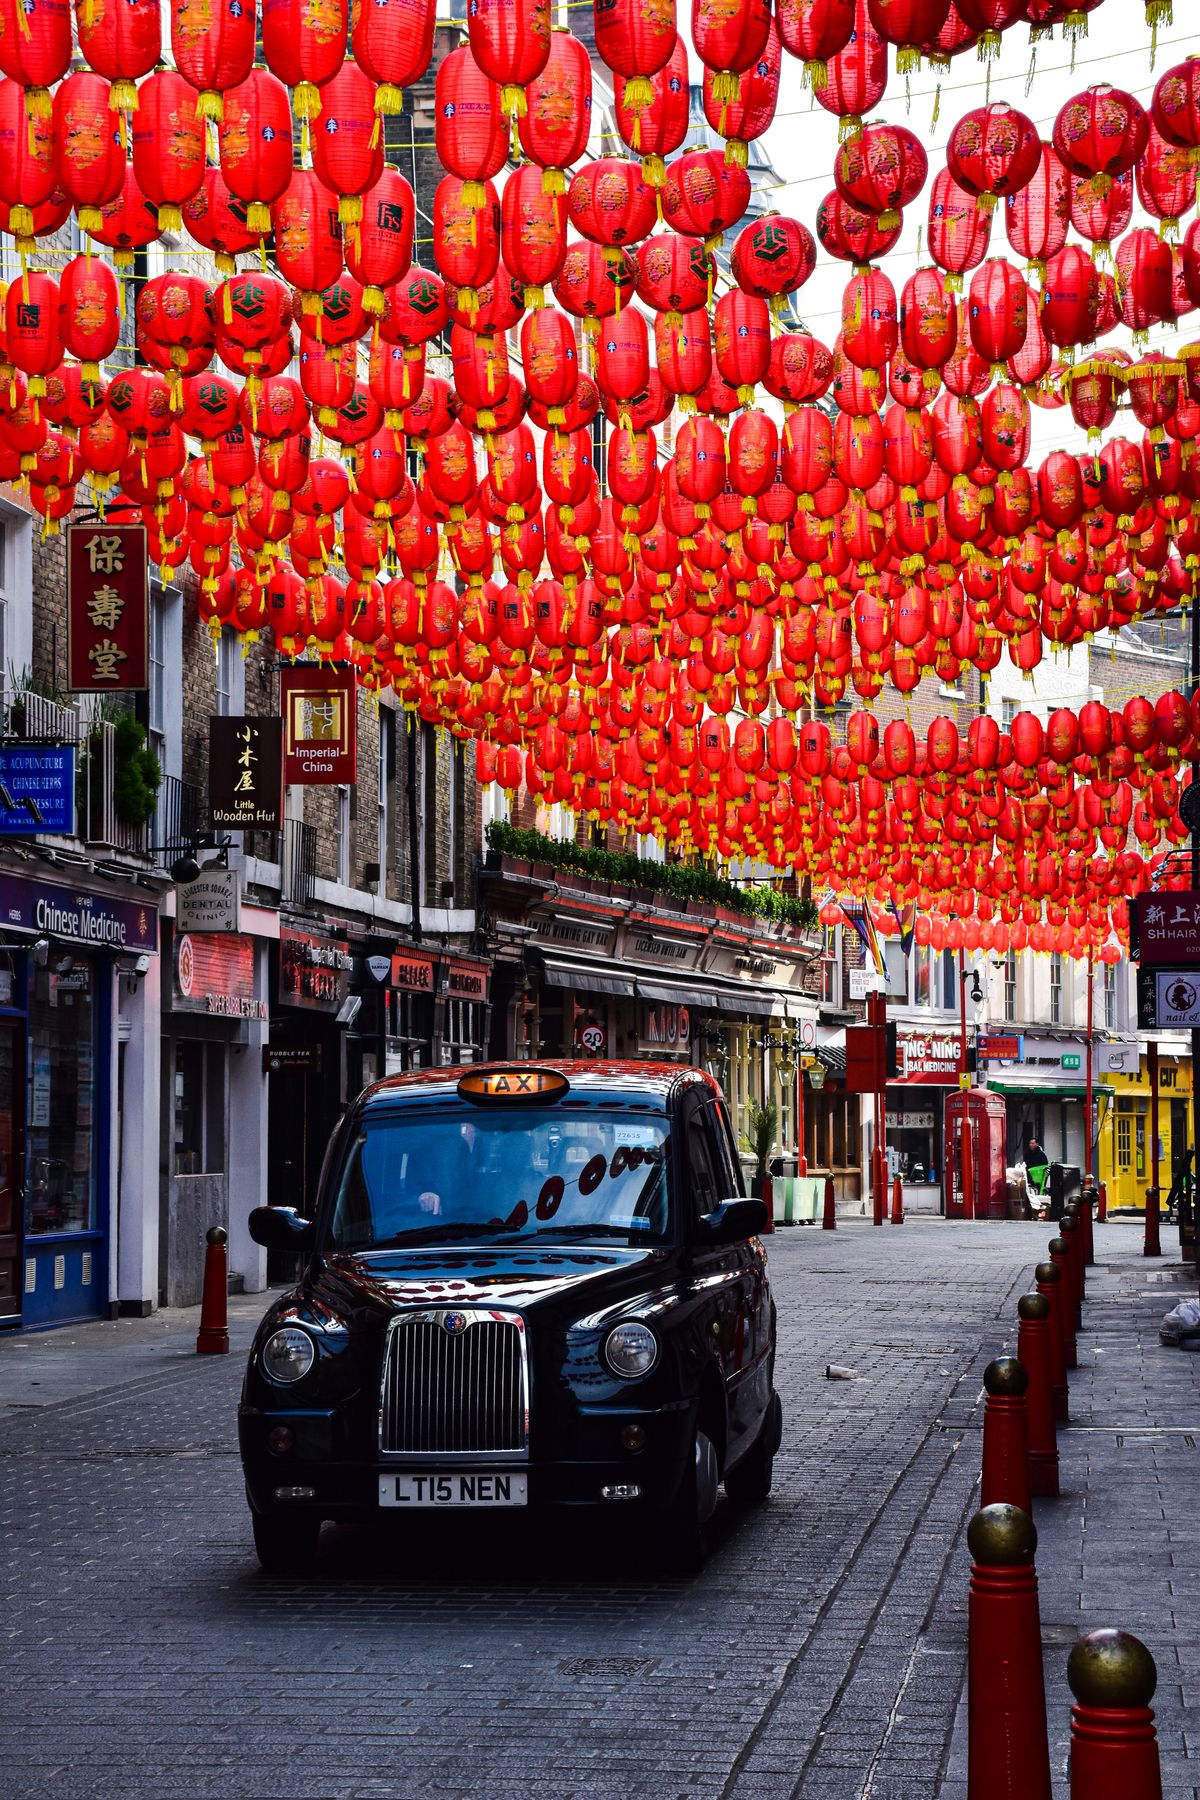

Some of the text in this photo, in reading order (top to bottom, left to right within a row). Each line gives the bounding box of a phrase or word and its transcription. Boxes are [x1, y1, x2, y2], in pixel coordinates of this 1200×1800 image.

[84, 535, 127, 680] 保壽堂
[234, 725, 259, 792] 小木屋
[296, 747, 339, 758] Imperial
[10, 757, 63, 769] ACUPUNCTURE
[302, 762, 333, 772] China
[13, 777, 61, 789] CHINESE HERBS
[234, 800, 255, 809] Little
[213, 809, 276, 822] Wooden Hut
[181, 883, 233, 899] LEICESTER SQUARE
[183, 901, 231, 909] DENTAL
[36, 898, 127, 944] Chinese Medicine
[187, 910, 226, 921] CLINIC
[582, 929, 595, 944] GAY
[1148, 928, 1197, 939] SH HAIR
[1166, 1011, 1187, 1022] nail
[584, 1032, 603, 1045] 20
[923, 1062, 957, 1073] MEDICINE
[1160, 1067, 1178, 1087] CUT
[480, 1075, 543, 1093] TAXI
[460, 1477, 511, 1501] NEN
